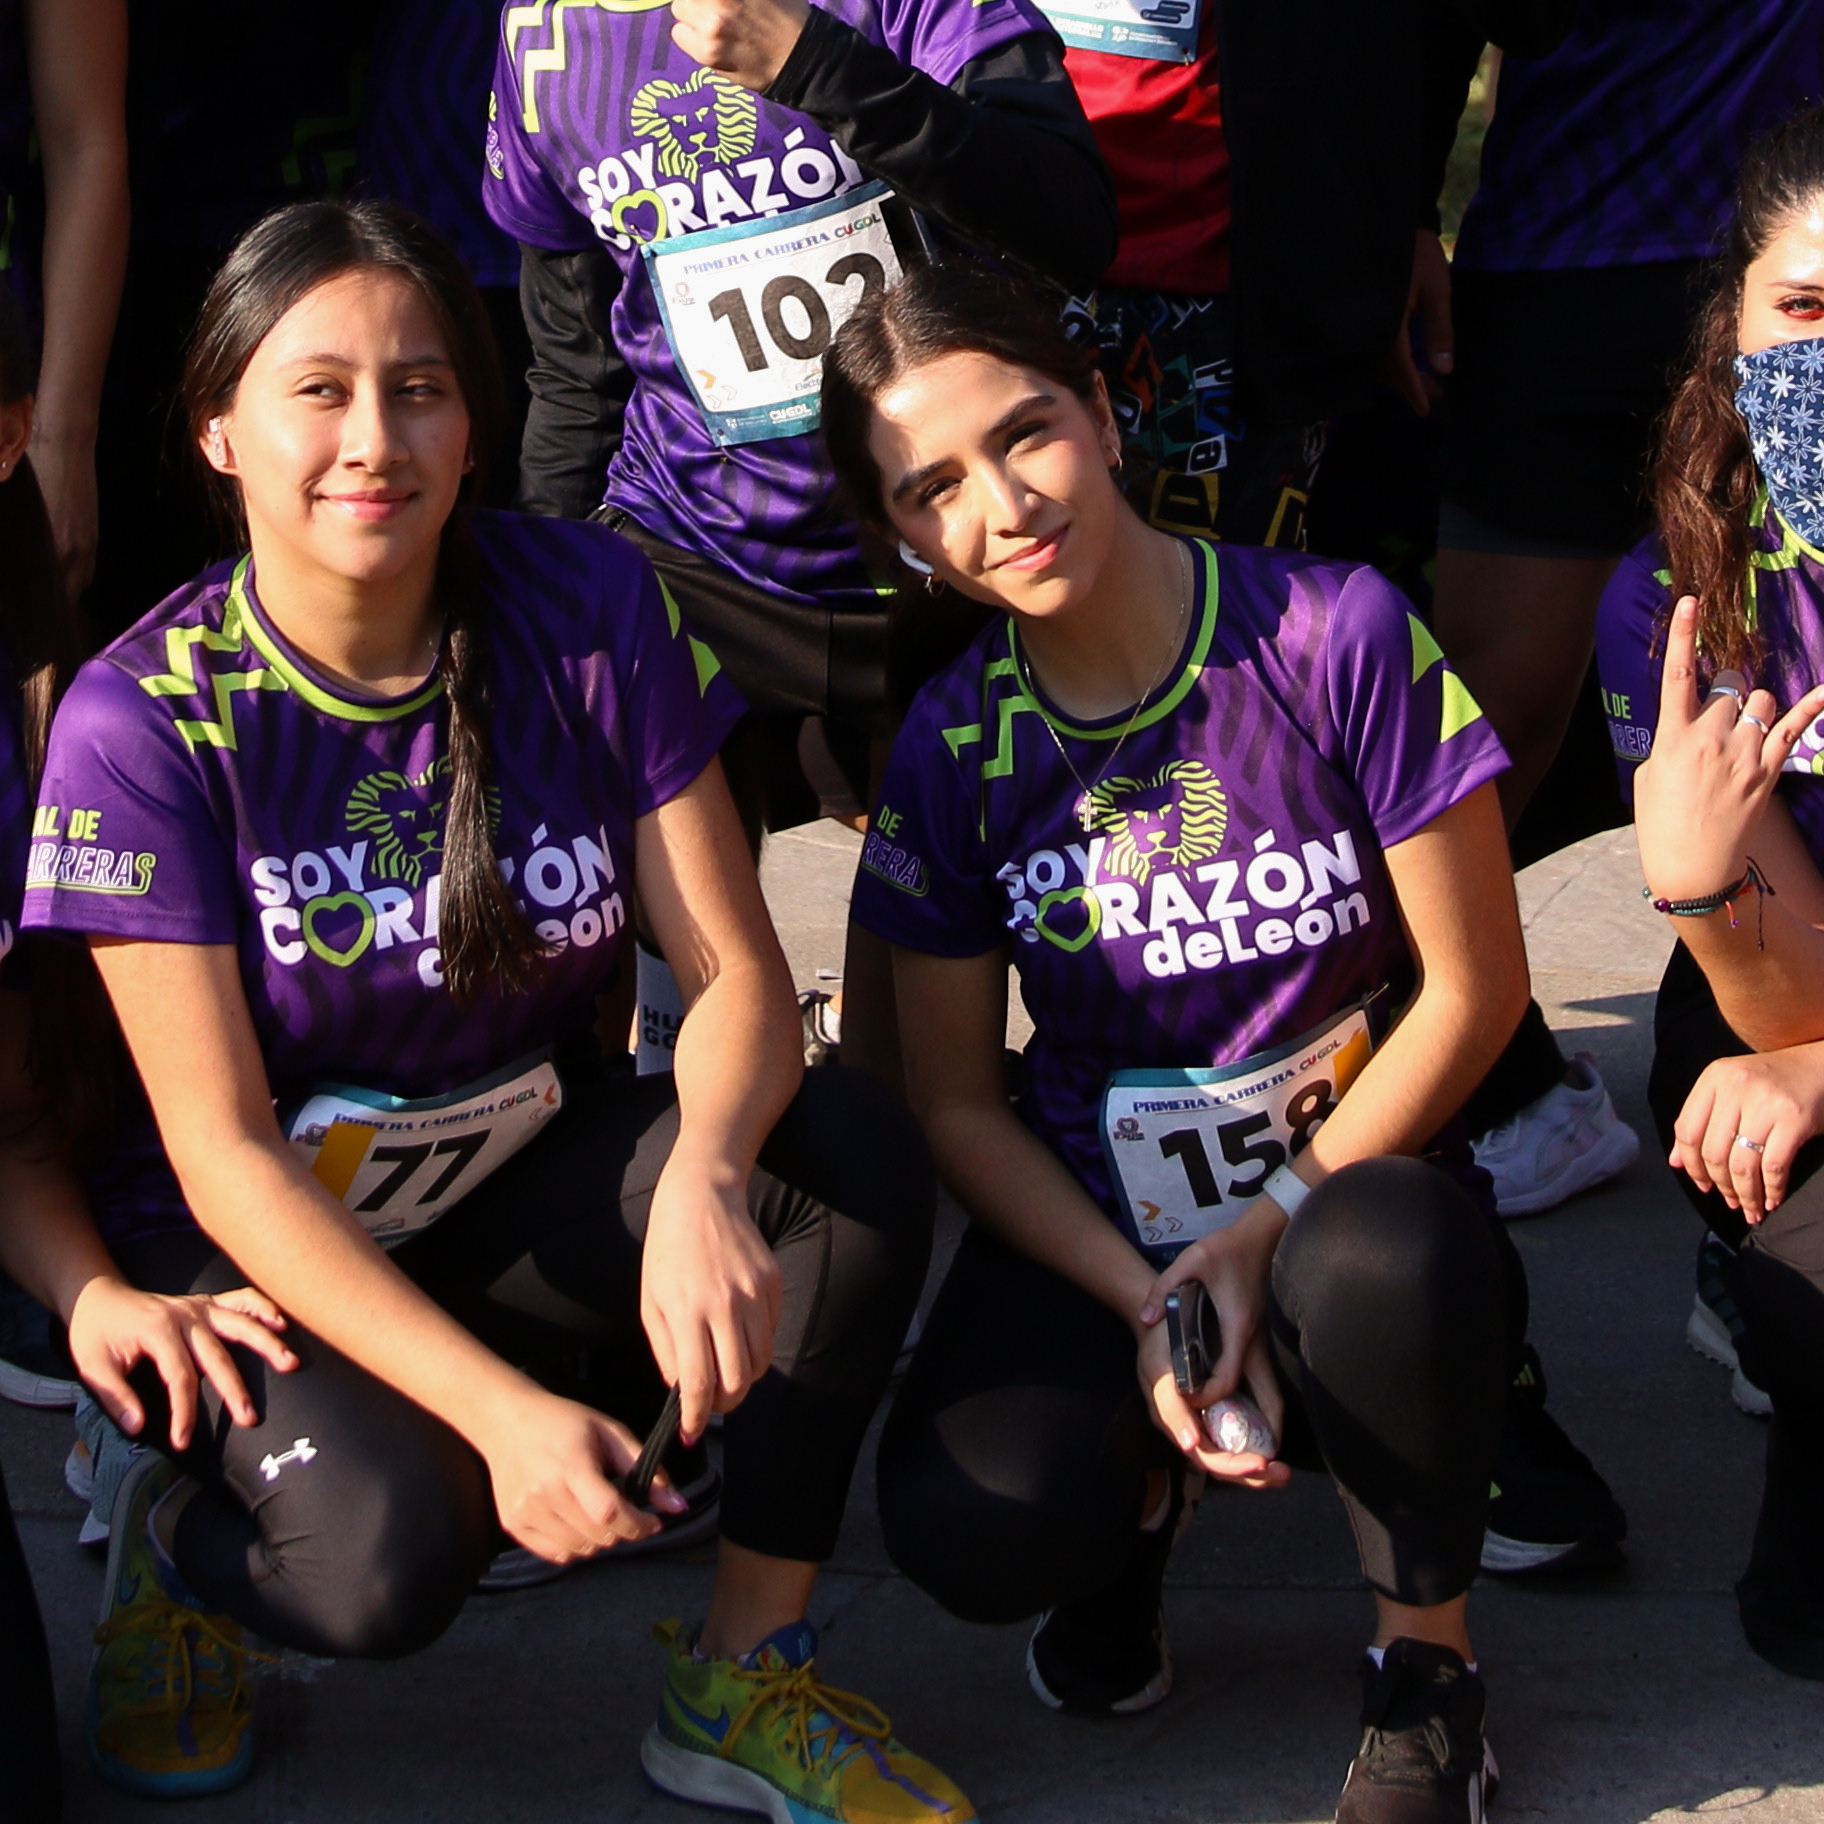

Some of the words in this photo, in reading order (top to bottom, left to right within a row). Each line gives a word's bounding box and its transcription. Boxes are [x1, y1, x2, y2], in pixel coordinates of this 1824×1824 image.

[577, 141, 658, 209] SOY
[684, 253, 750, 275] PRIMERA
[754, 232, 831, 260] CARRERA
[834, 212, 882, 238] CUGDL
[708, 252, 887, 373] 102
[769, 403, 813, 422] CUGDL
[1612, 694, 1632, 720] DE
[68, 808, 102, 841] DE
[877, 805, 903, 838] DE
[249, 837, 372, 910] SOY
[419, 1103, 495, 1129] CARRERA
[498, 1085, 538, 1111] CUGDL
[1133, 1098, 1209, 1113] PRIMERA
[1214, 1068, 1296, 1106] CARRERA
[1299, 1039, 1342, 1072] CUGDL
[353, 1127, 492, 1212] 77
[1158, 1078, 1339, 1209] 158
